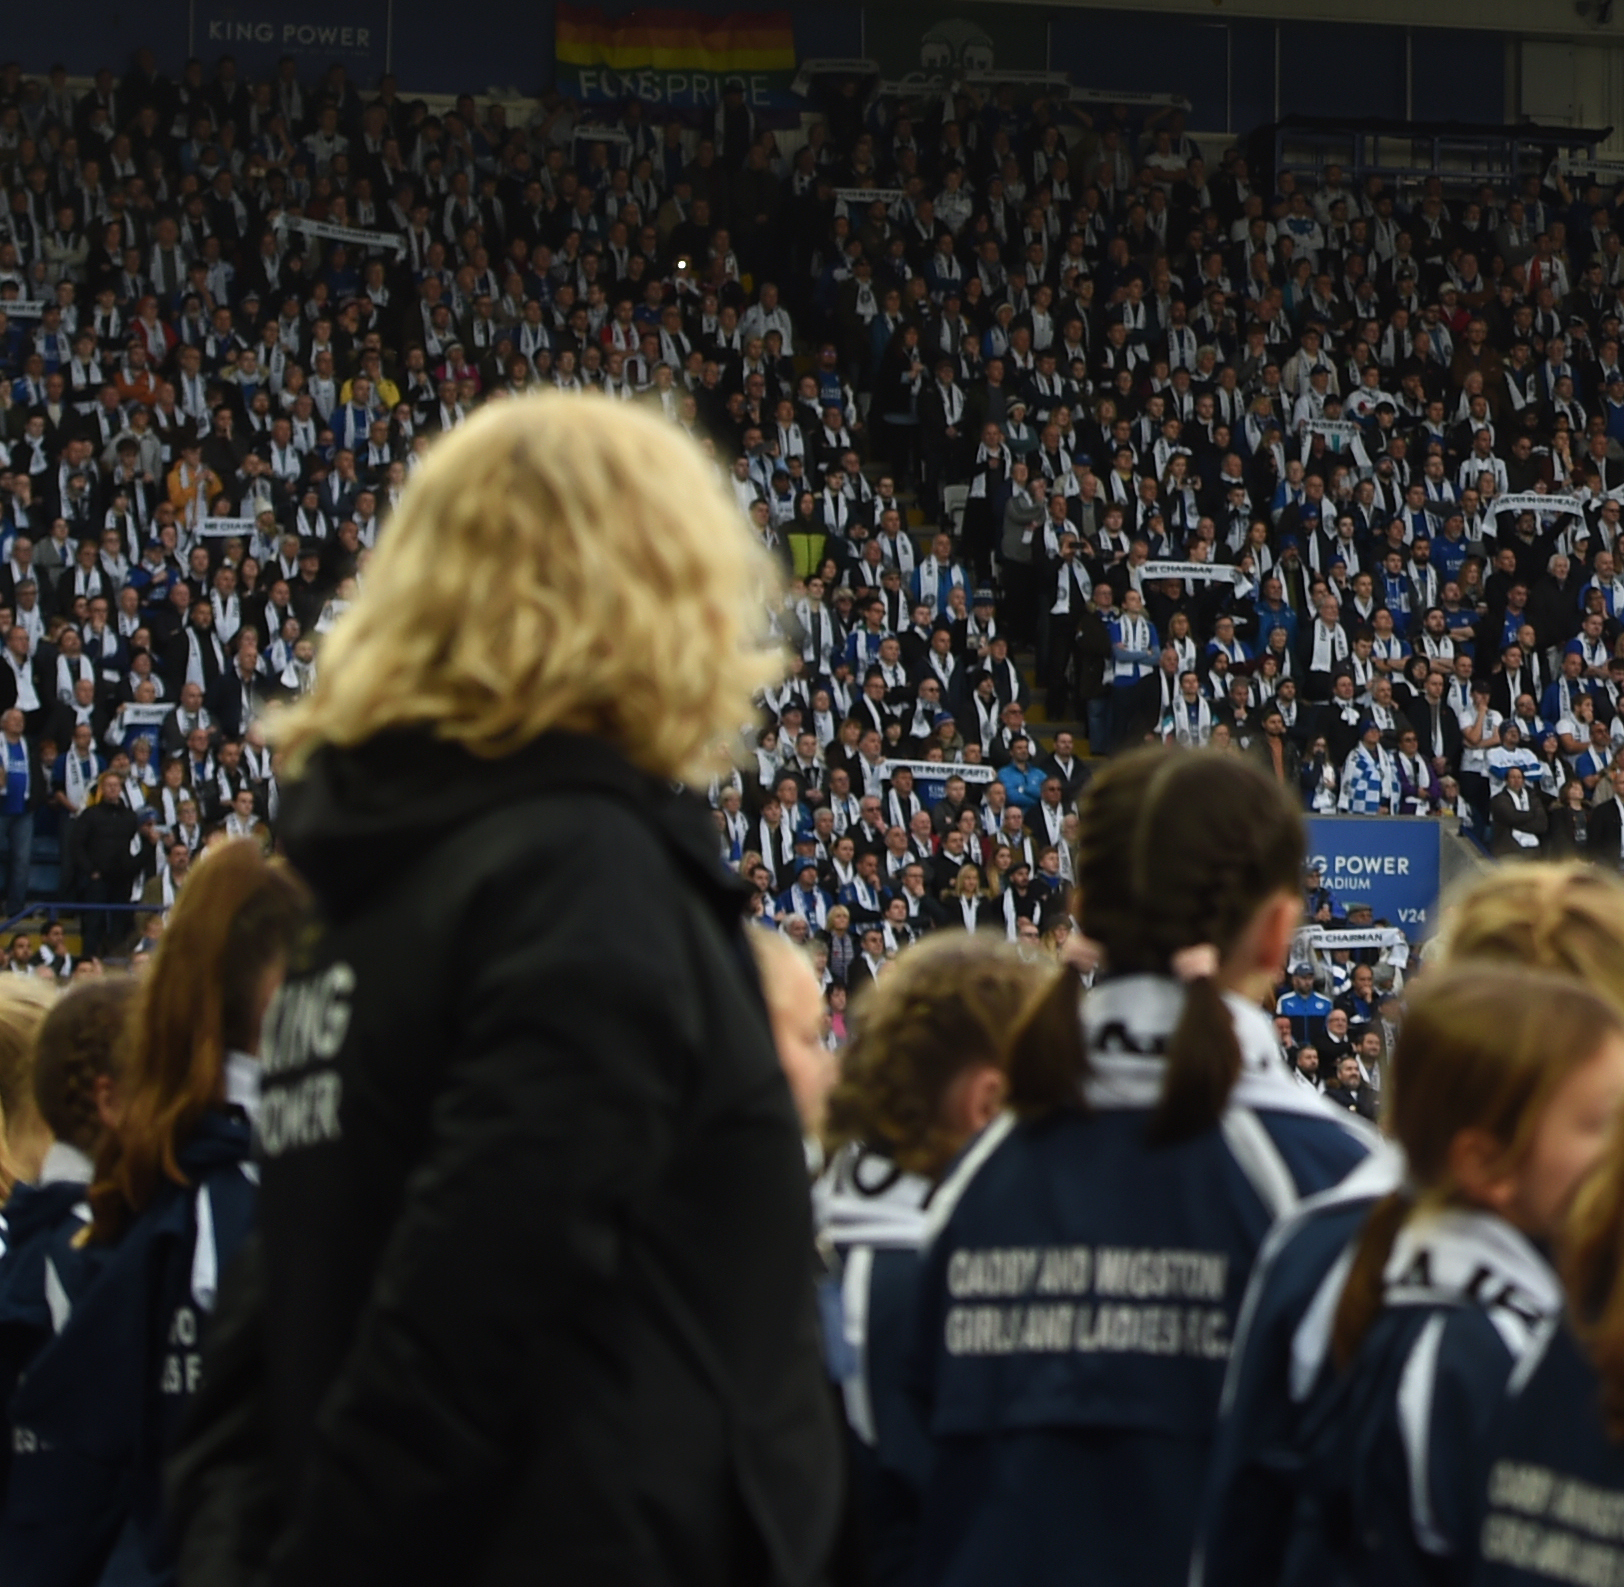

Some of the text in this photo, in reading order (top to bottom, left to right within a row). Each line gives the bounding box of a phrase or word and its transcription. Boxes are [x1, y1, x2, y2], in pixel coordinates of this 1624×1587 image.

[209, 19, 370, 48] KING POWER
[1160, 566, 1212, 574] CHAIRMAN
[1334, 855, 1409, 876] POWER
[1397, 908, 1426, 924] V24
[1325, 933, 1384, 943] CHAIRMAN
